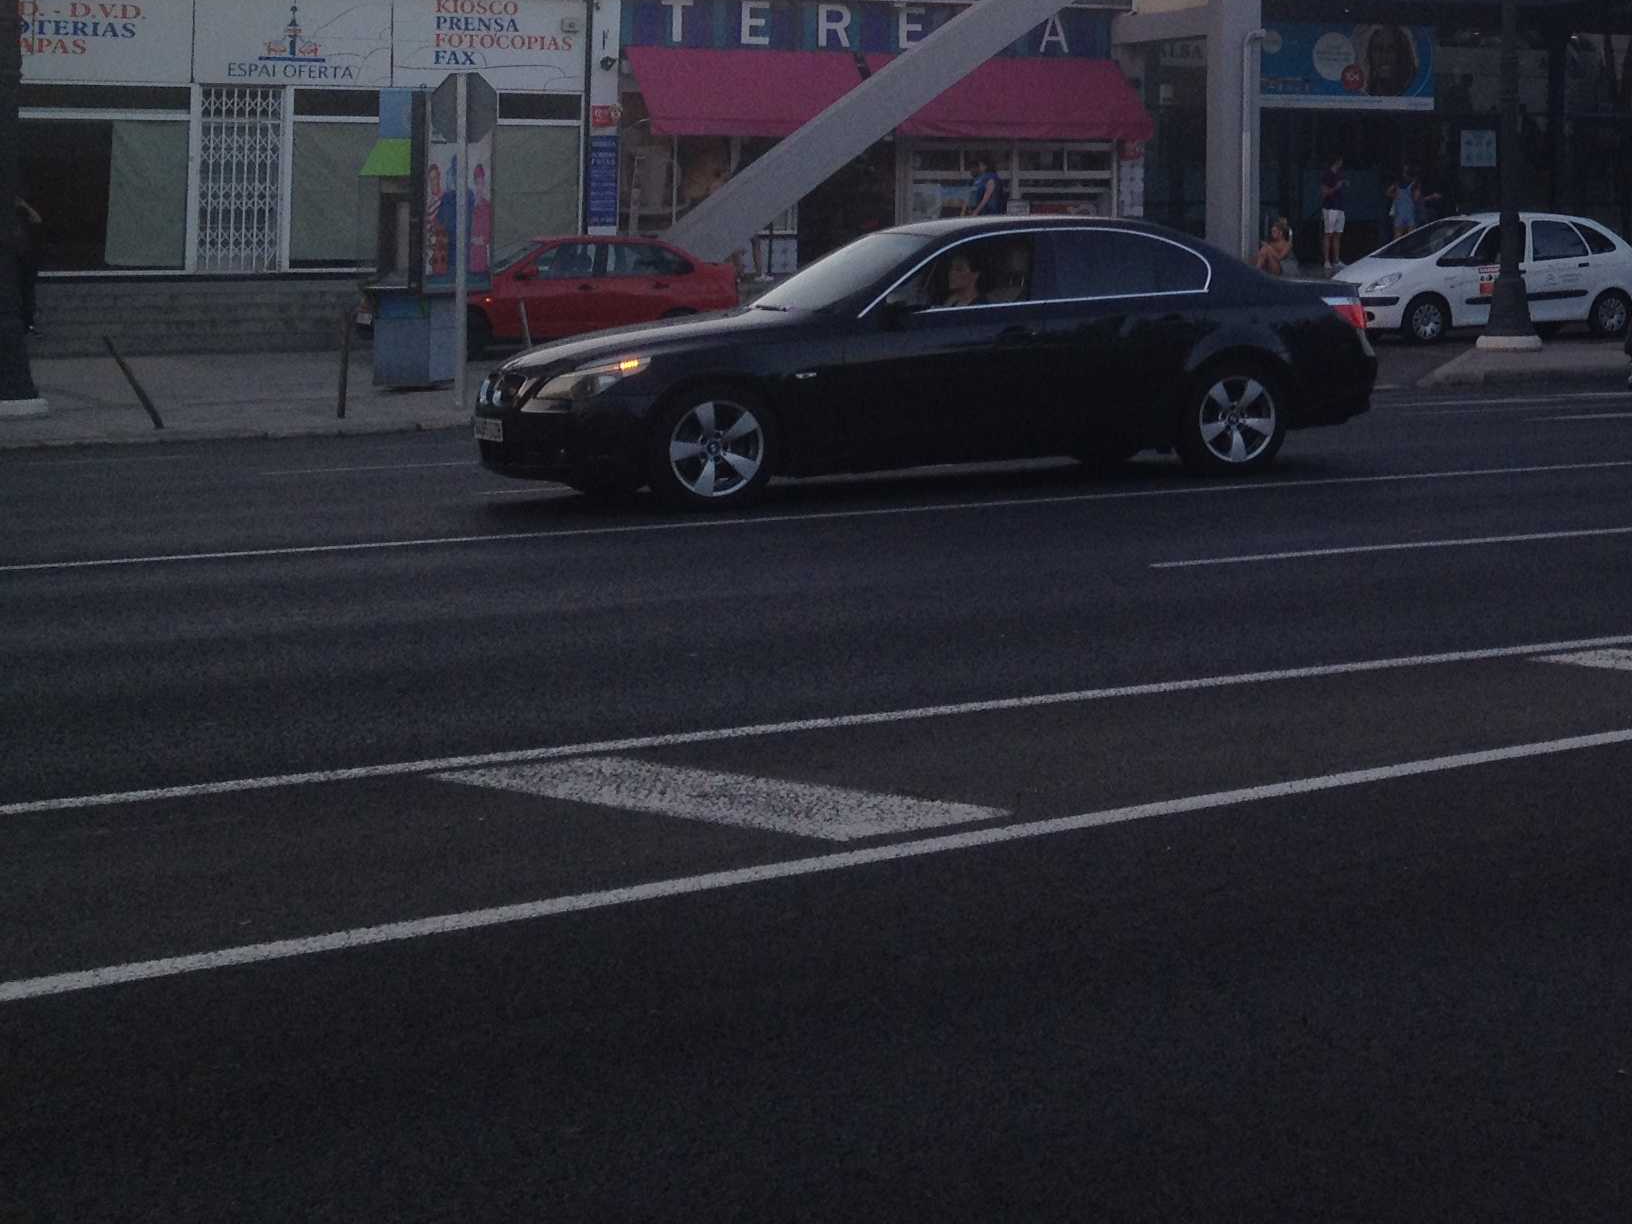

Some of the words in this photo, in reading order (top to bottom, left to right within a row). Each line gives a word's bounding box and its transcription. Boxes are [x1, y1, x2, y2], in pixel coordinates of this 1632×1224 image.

[435, 16, 519, 33] PRENSA
[434, 33, 573, 51] FOTOCOPIAS
[433, 50, 476, 65] FAX
[227, 62, 276, 77] ESPAI
[282, 63, 354, 79] OFERTA
